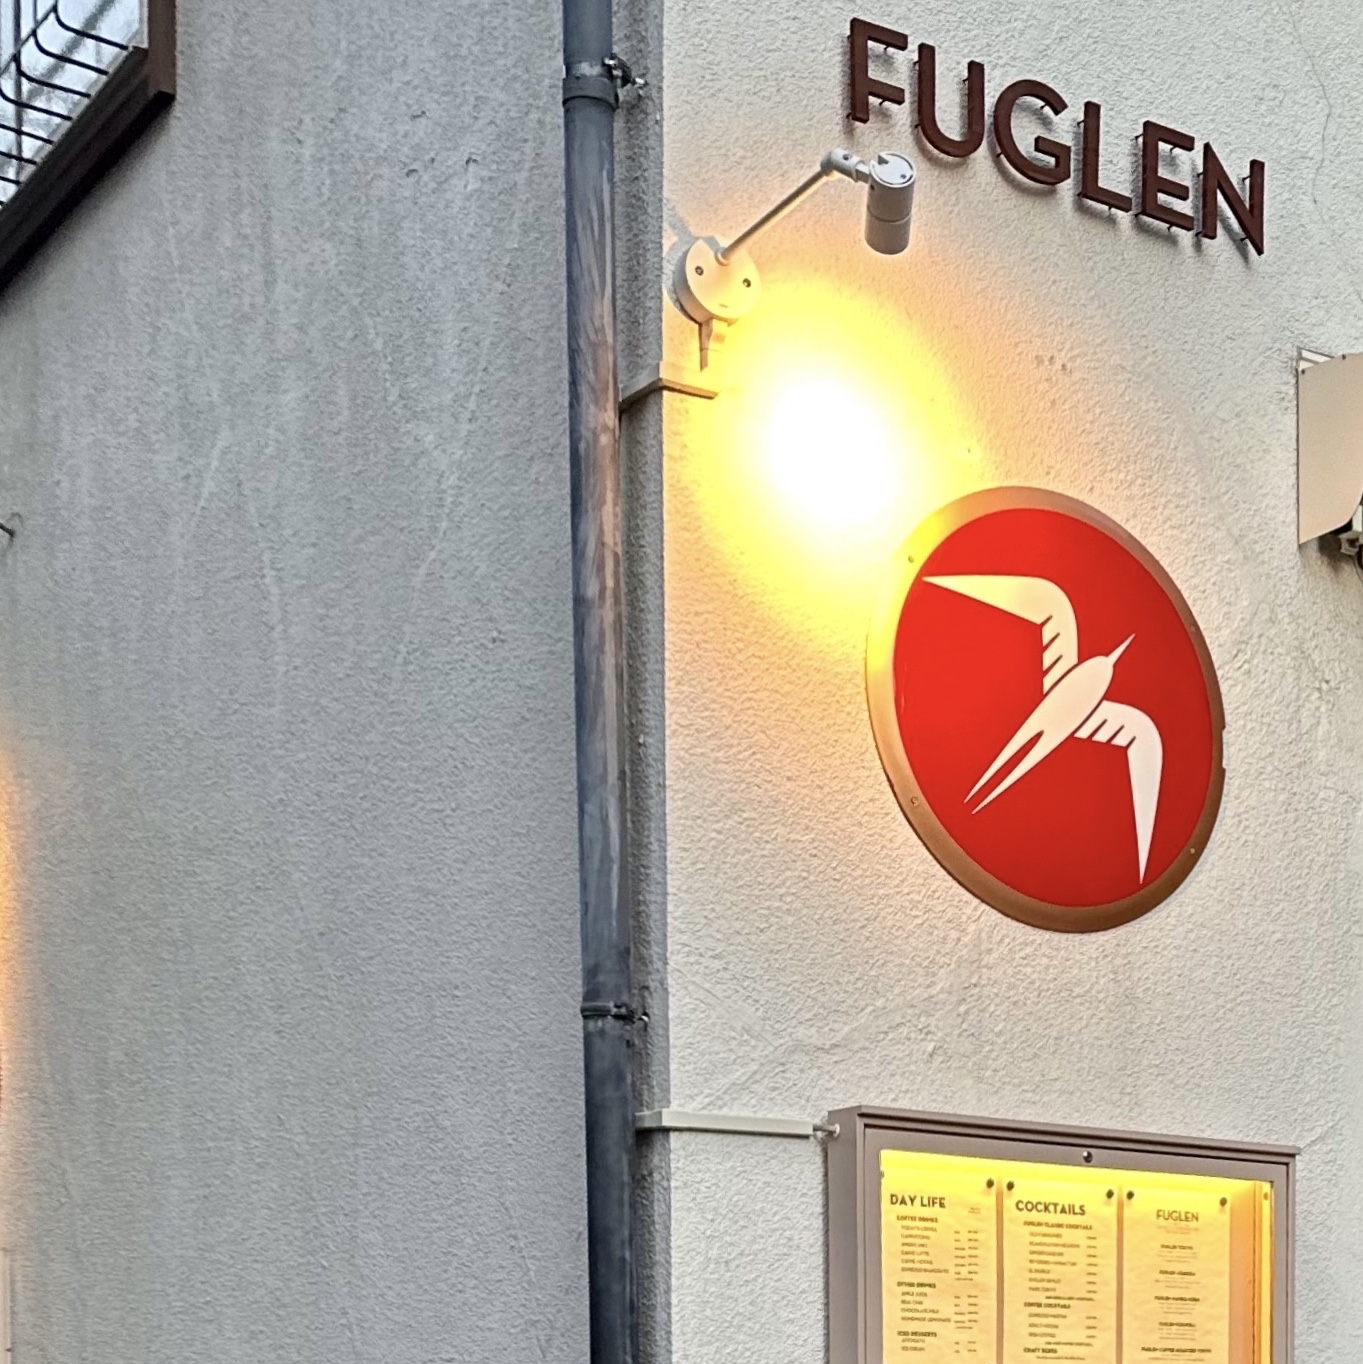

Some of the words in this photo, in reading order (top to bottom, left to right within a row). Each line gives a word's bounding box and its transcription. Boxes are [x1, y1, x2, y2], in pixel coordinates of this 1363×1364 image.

[849, 17, 1265, 256] FUGLEN
[890, 1193, 917, 1207] DAY
[920, 1195, 946, 1209] LIFE
[1015, 1200, 1086, 1216] COCKTAILS
[1156, 1209, 1199, 1222] FUGLEN
